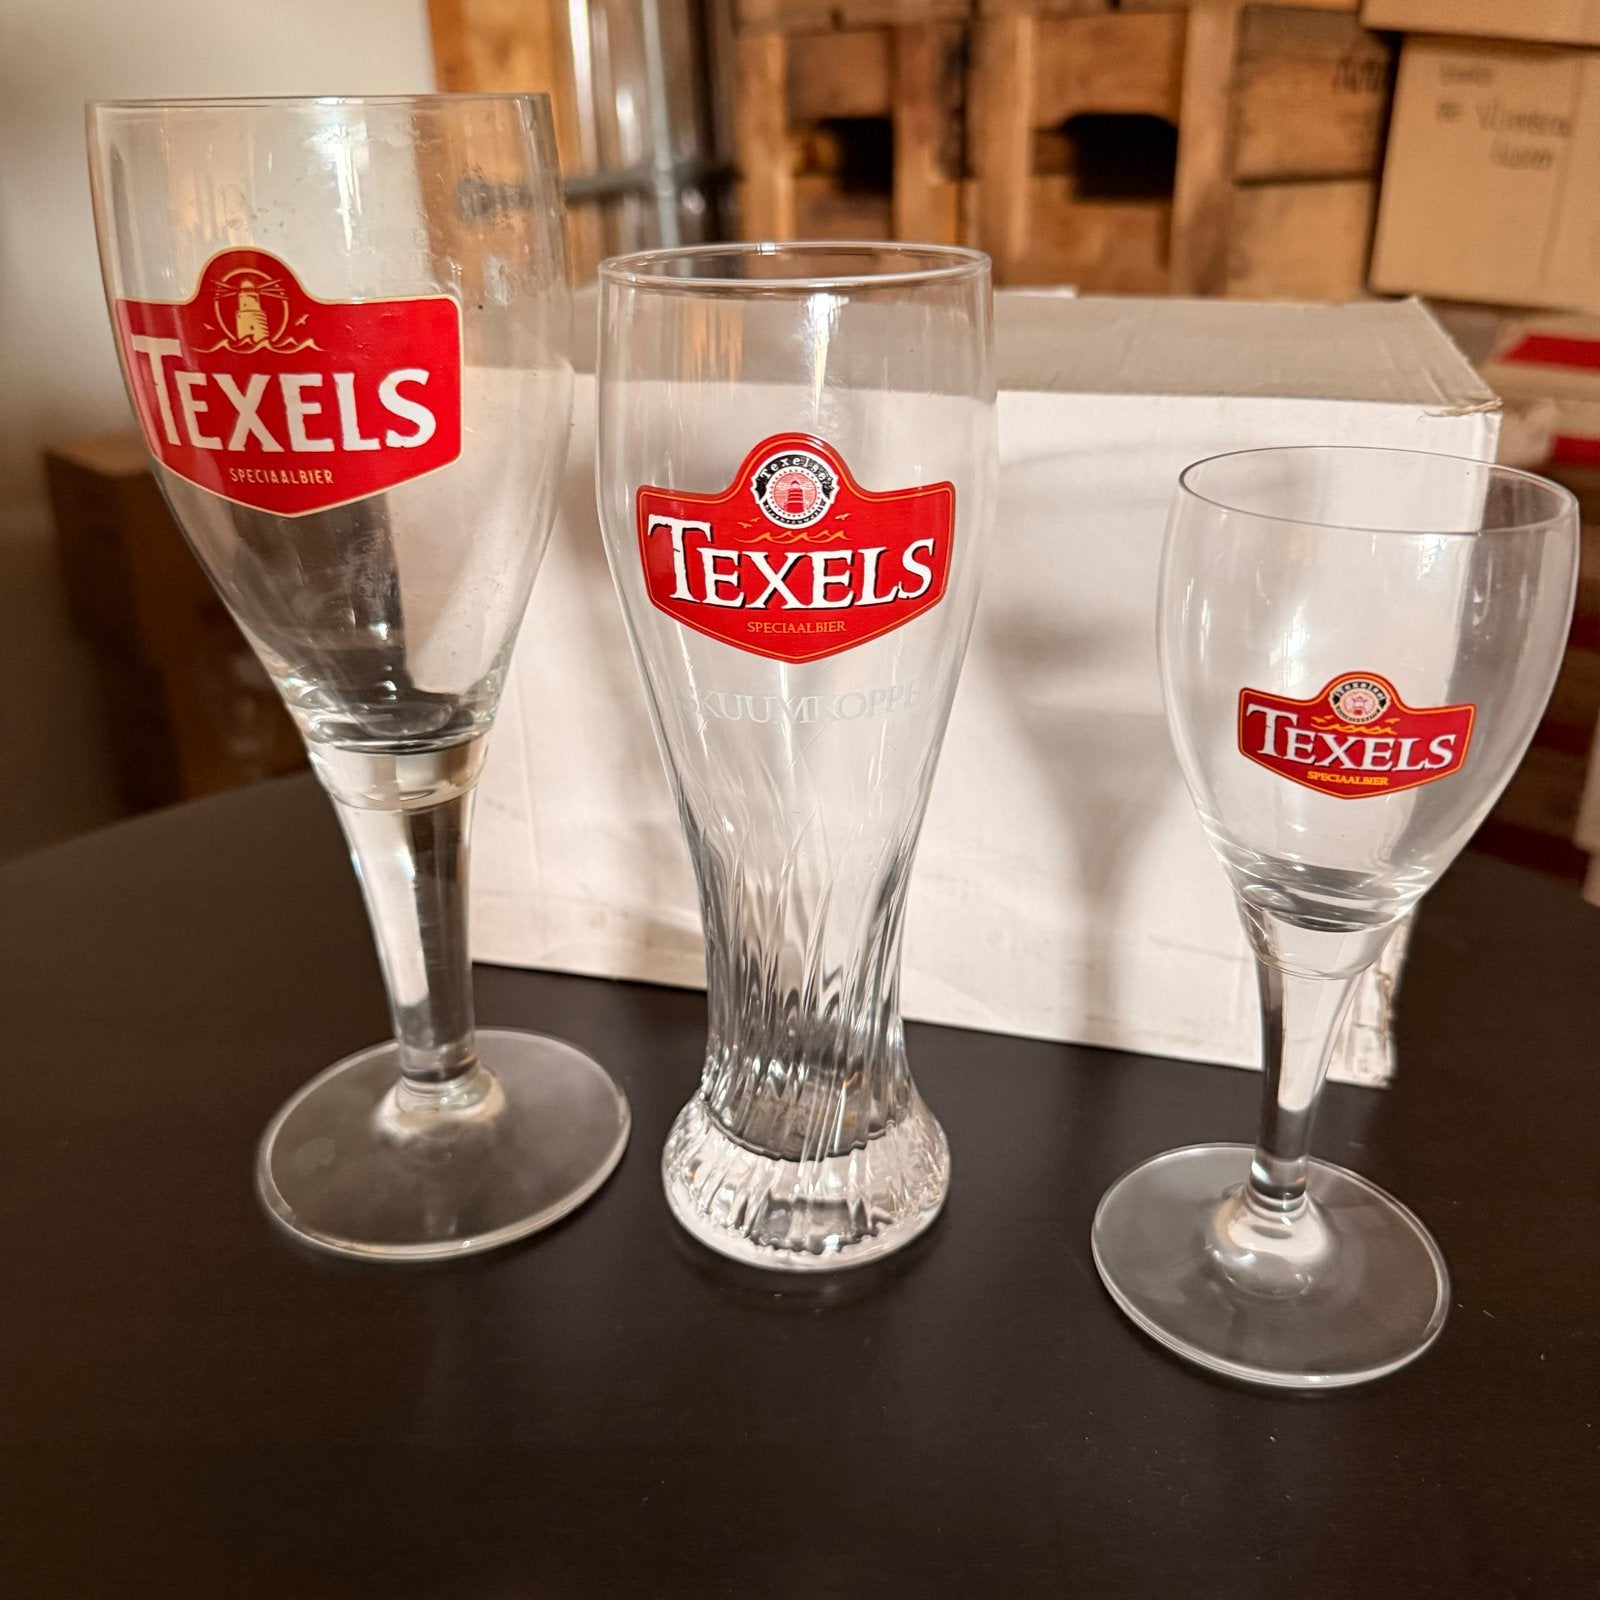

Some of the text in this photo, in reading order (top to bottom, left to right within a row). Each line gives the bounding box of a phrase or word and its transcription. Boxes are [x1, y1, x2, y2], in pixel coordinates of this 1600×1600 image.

[132, 334, 437, 453] TEXELS
[229, 467, 335, 485] SPECIAALBIER
[647, 513, 936, 611] TEXELS
[747, 620, 846, 634] SPECIAALBIER
[1246, 703, 1457, 772] TEXELS
[1307, 770, 1389, 786] SPECIAALBIER
